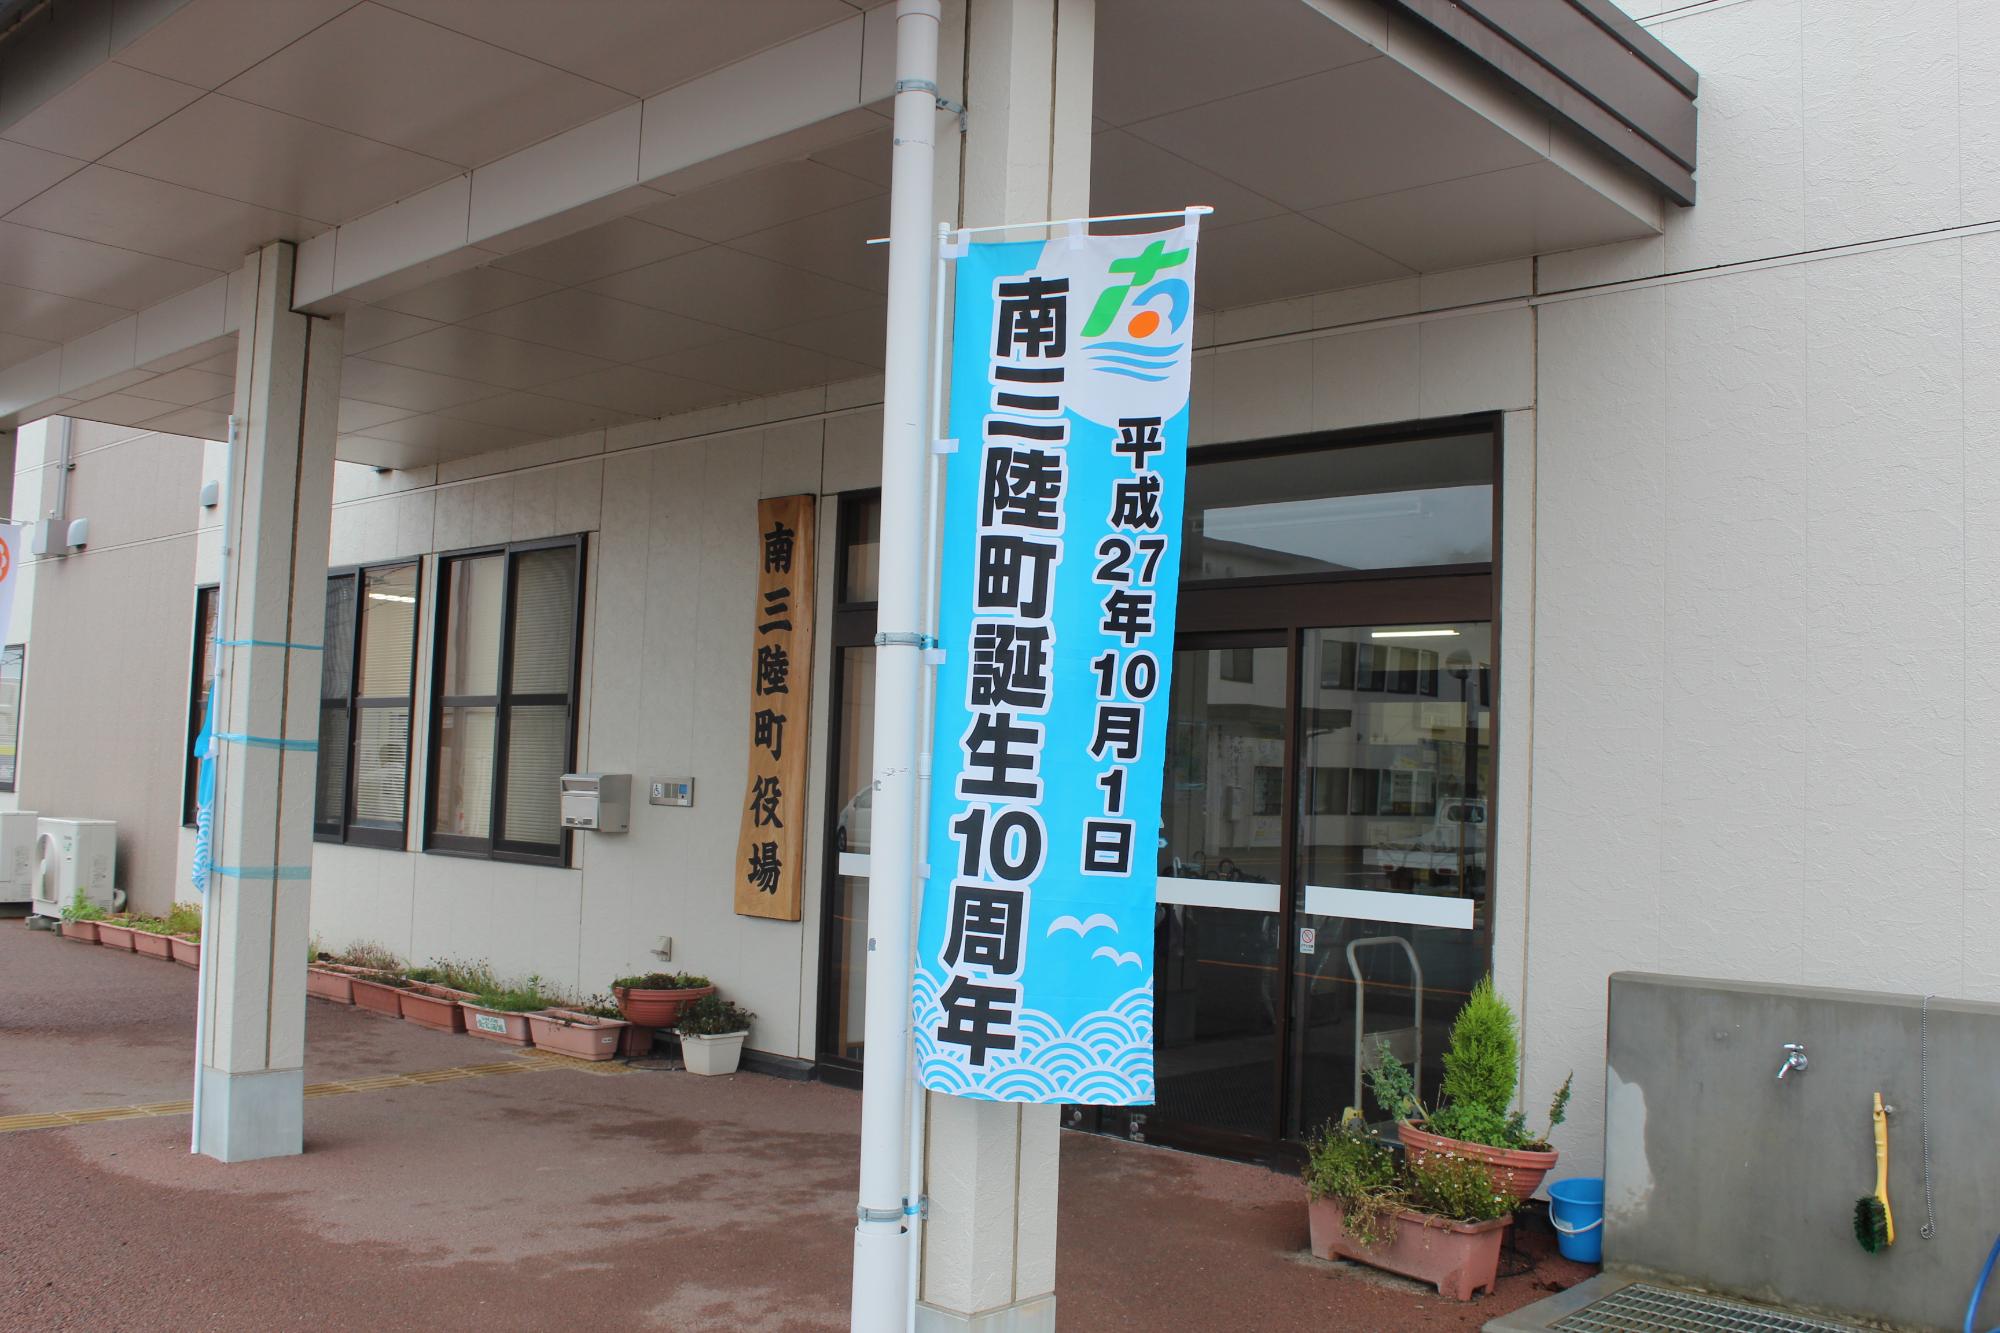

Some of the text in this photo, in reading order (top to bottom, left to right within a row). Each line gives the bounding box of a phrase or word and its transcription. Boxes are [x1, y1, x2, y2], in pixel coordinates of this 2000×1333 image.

[747, 520, 796, 895] 南三陸町役場
[937, 276, 1070, 1066] 南三陸町誕生10周年
[1084, 417, 1164, 873] 平成27年10月1日
